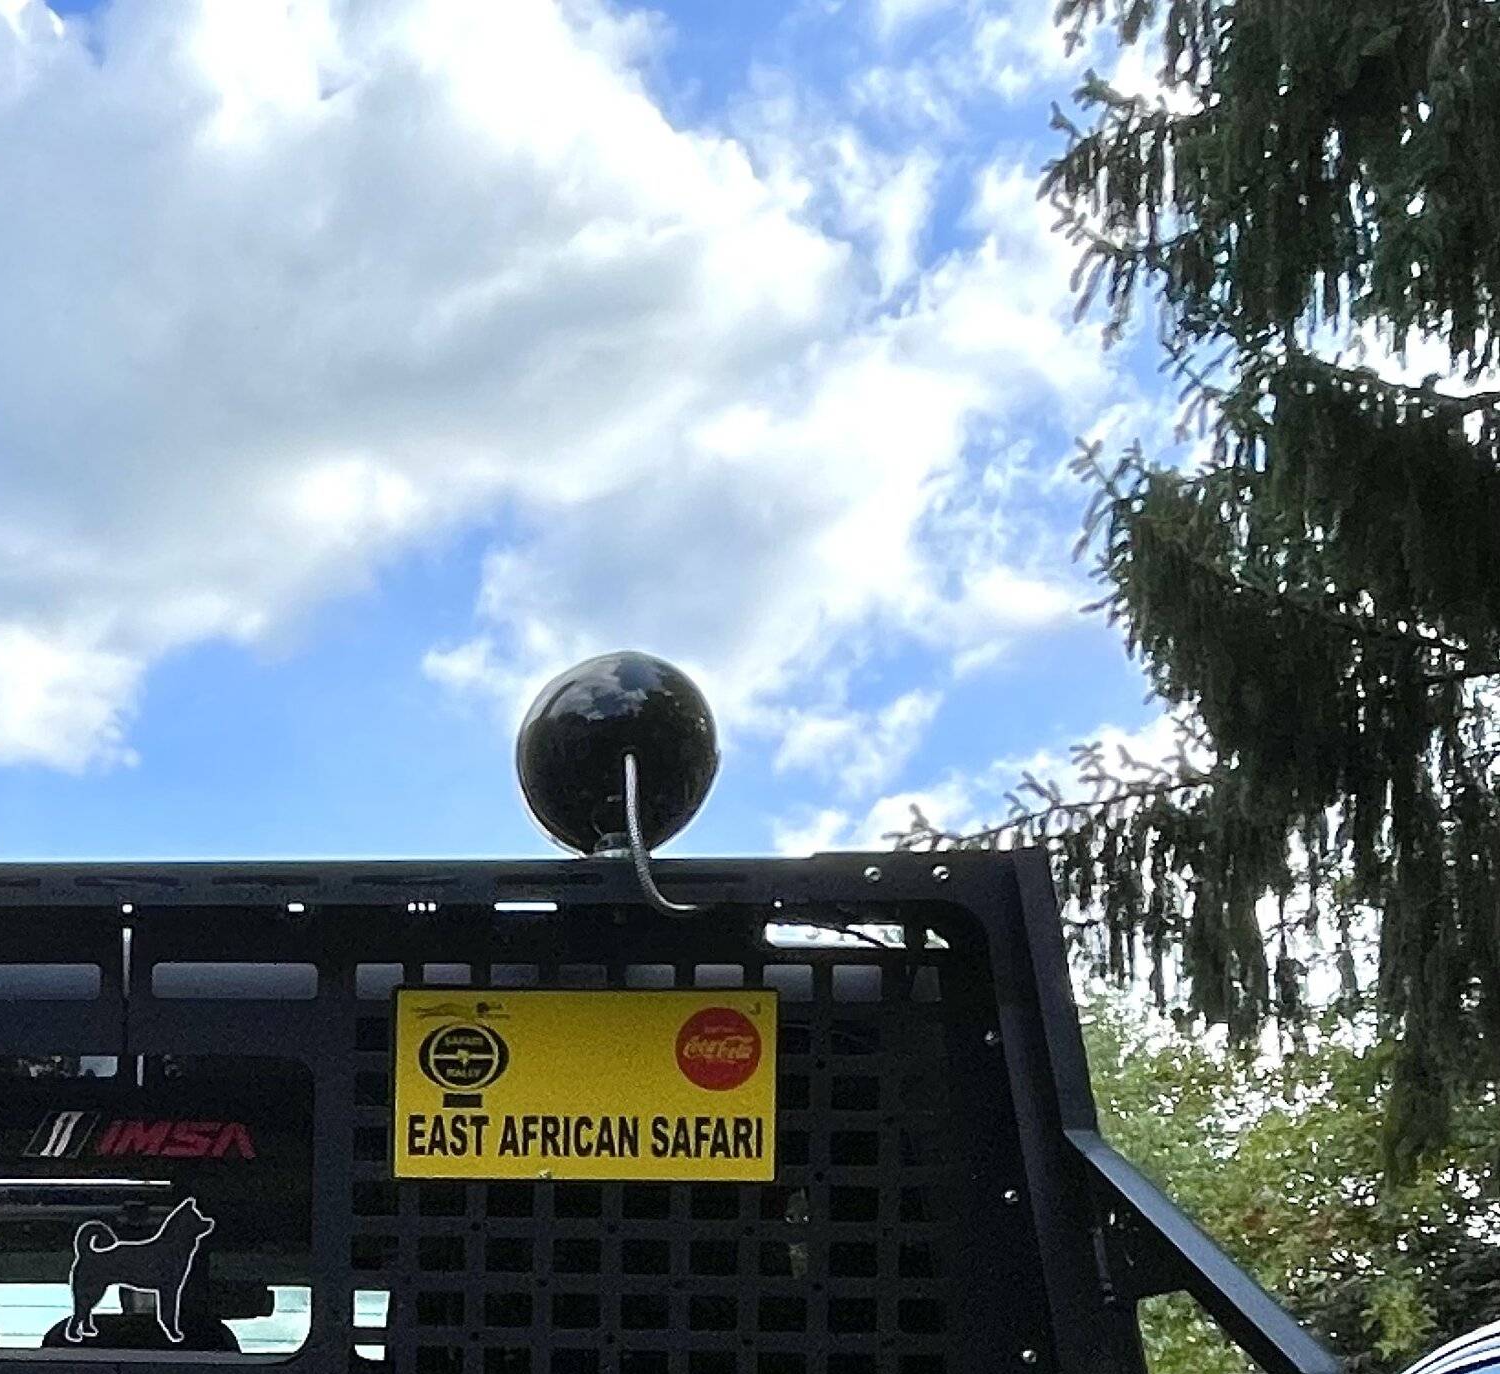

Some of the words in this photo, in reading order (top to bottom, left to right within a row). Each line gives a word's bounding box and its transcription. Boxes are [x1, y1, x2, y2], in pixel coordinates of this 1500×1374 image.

[95, 1119, 256, 1159] IMSA
[407, 1114, 490, 1157] EAST
[499, 1115, 640, 1159] AFRICAN
[650, 1115, 763, 1159] SAFARI
